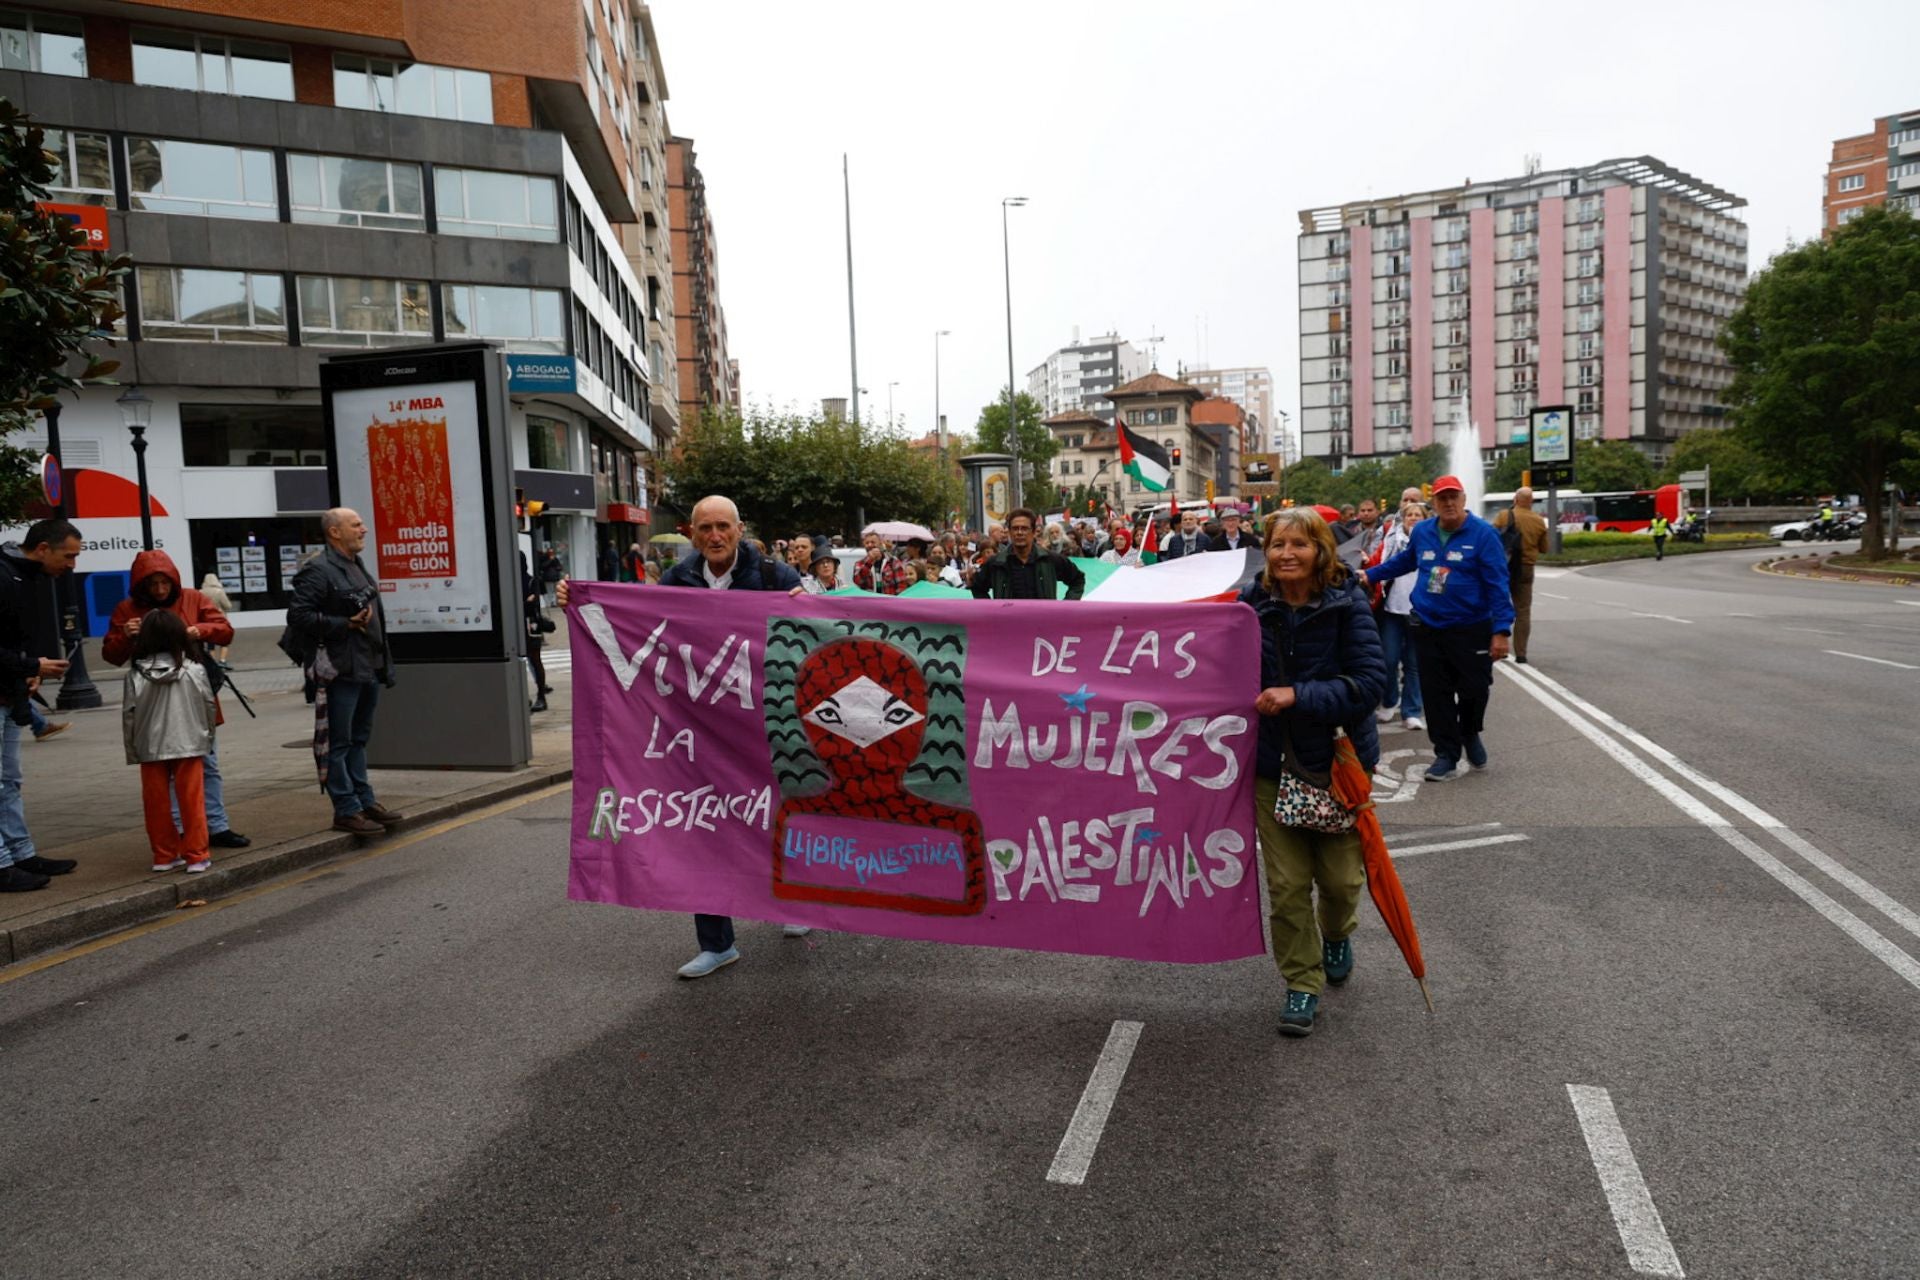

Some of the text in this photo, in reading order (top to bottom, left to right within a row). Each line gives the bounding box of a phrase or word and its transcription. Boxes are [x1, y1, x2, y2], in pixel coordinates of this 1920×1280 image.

[516, 364, 570, 374] ABOGADA
[409, 397, 444, 411] MBA
[398, 521, 449, 540] media
[80, 537, 164, 550] saelite.s
[382, 537, 449, 556] maratón
[409, 554, 450, 571] GIJÓN
[1032, 625, 1196, 678] DE LAS
[644, 715, 694, 762] LA
[974, 697, 1247, 795] MUJERES
